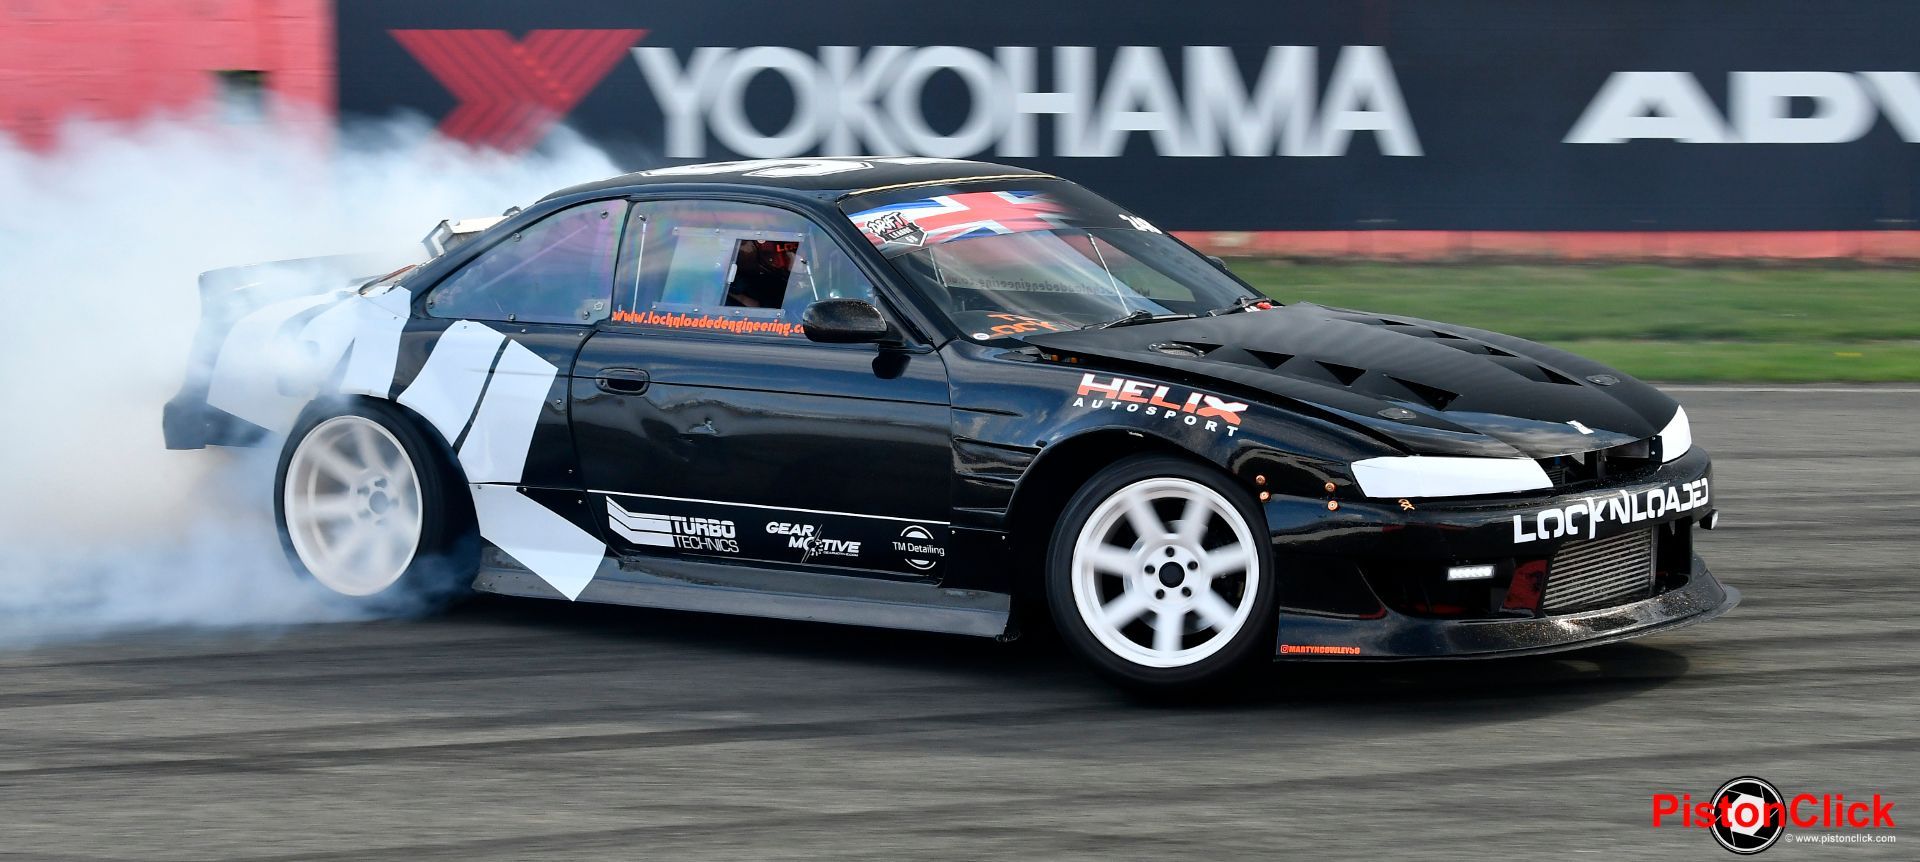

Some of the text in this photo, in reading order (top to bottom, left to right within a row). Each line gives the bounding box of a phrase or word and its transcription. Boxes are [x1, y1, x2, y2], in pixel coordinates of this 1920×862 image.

[632, 45, 1424, 158] YOKOHAMA
[866, 212, 905, 234] DRIFT
[1077, 373, 1249, 426] HELIX
[1073, 397, 1239, 437] AUTOSPORT
[669, 515, 736, 539] TURBO
[765, 521, 814, 537] GEAR
[672, 534, 740, 553] TECHNICS
[892, 541, 945, 556] TM Detailing
